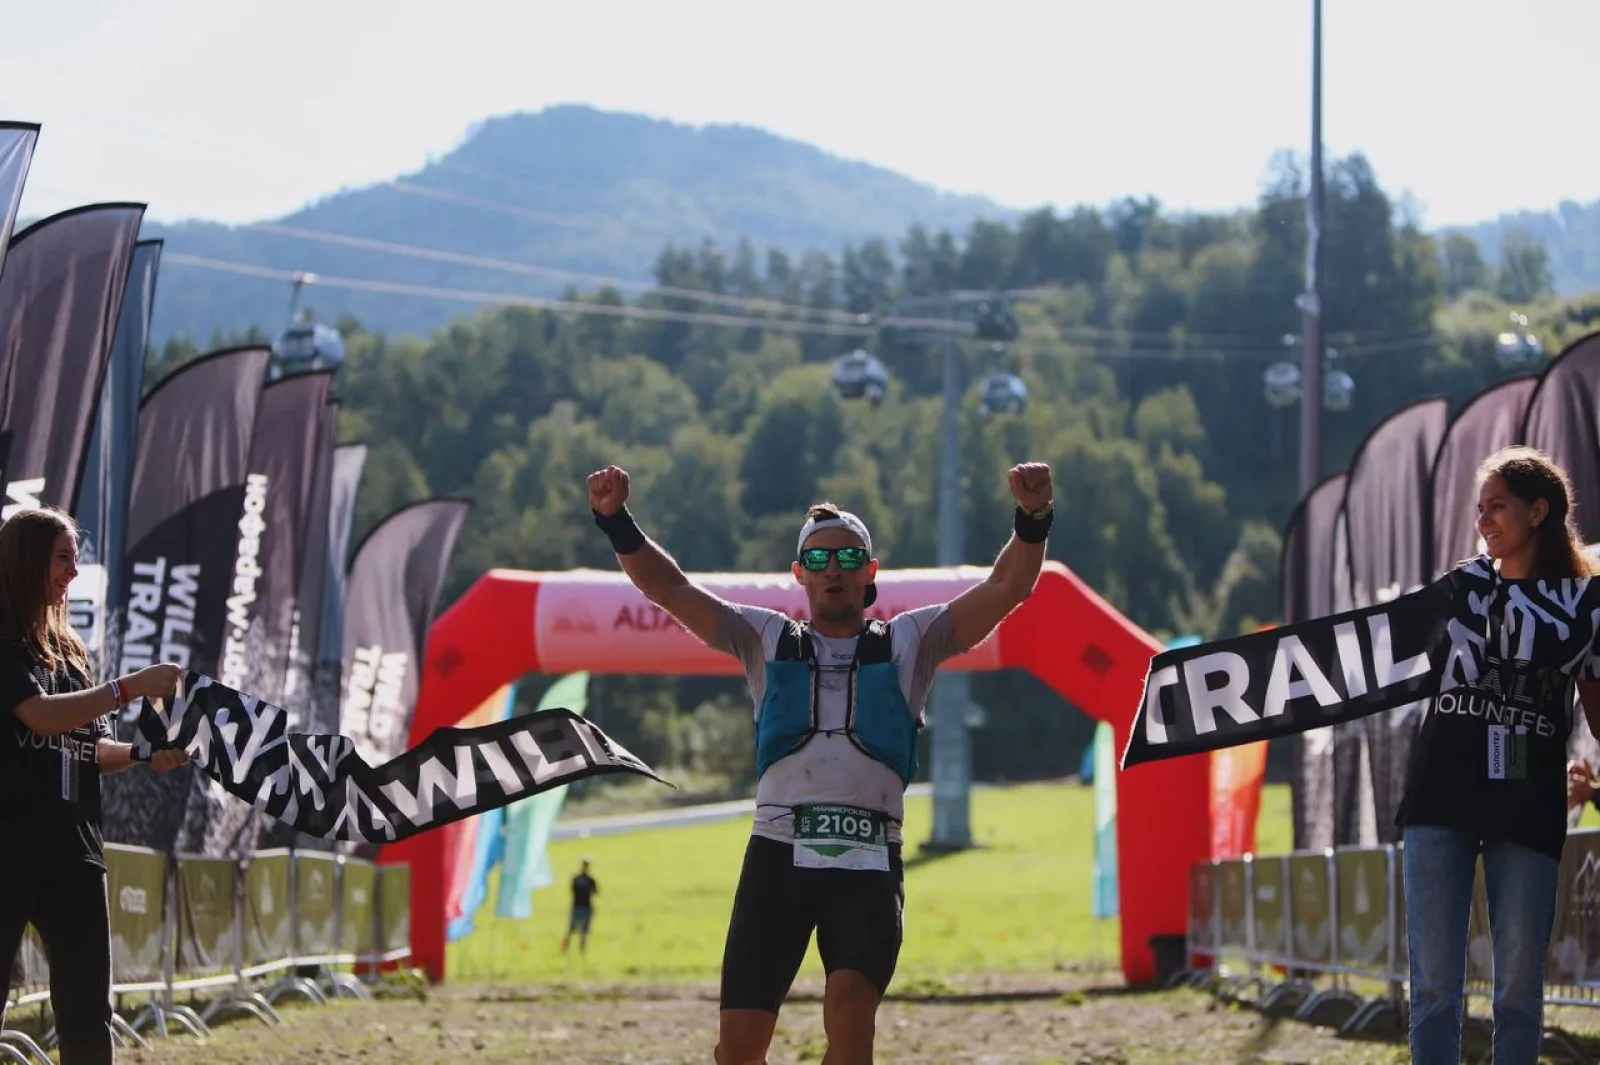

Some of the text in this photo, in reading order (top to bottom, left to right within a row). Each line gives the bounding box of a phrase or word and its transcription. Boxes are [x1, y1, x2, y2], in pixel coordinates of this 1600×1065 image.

[160, 563, 201, 670] WILD
[613, 604, 686, 632] ALTA
[119, 556, 167, 723] TRAIL
[1146, 612, 1431, 746] TRAIL
[1434, 693, 1557, 738] OLUNTEE
[1493, 731, 1501, 774] ВОЛОНТЕР
[816, 814, 872, 838] 2109
